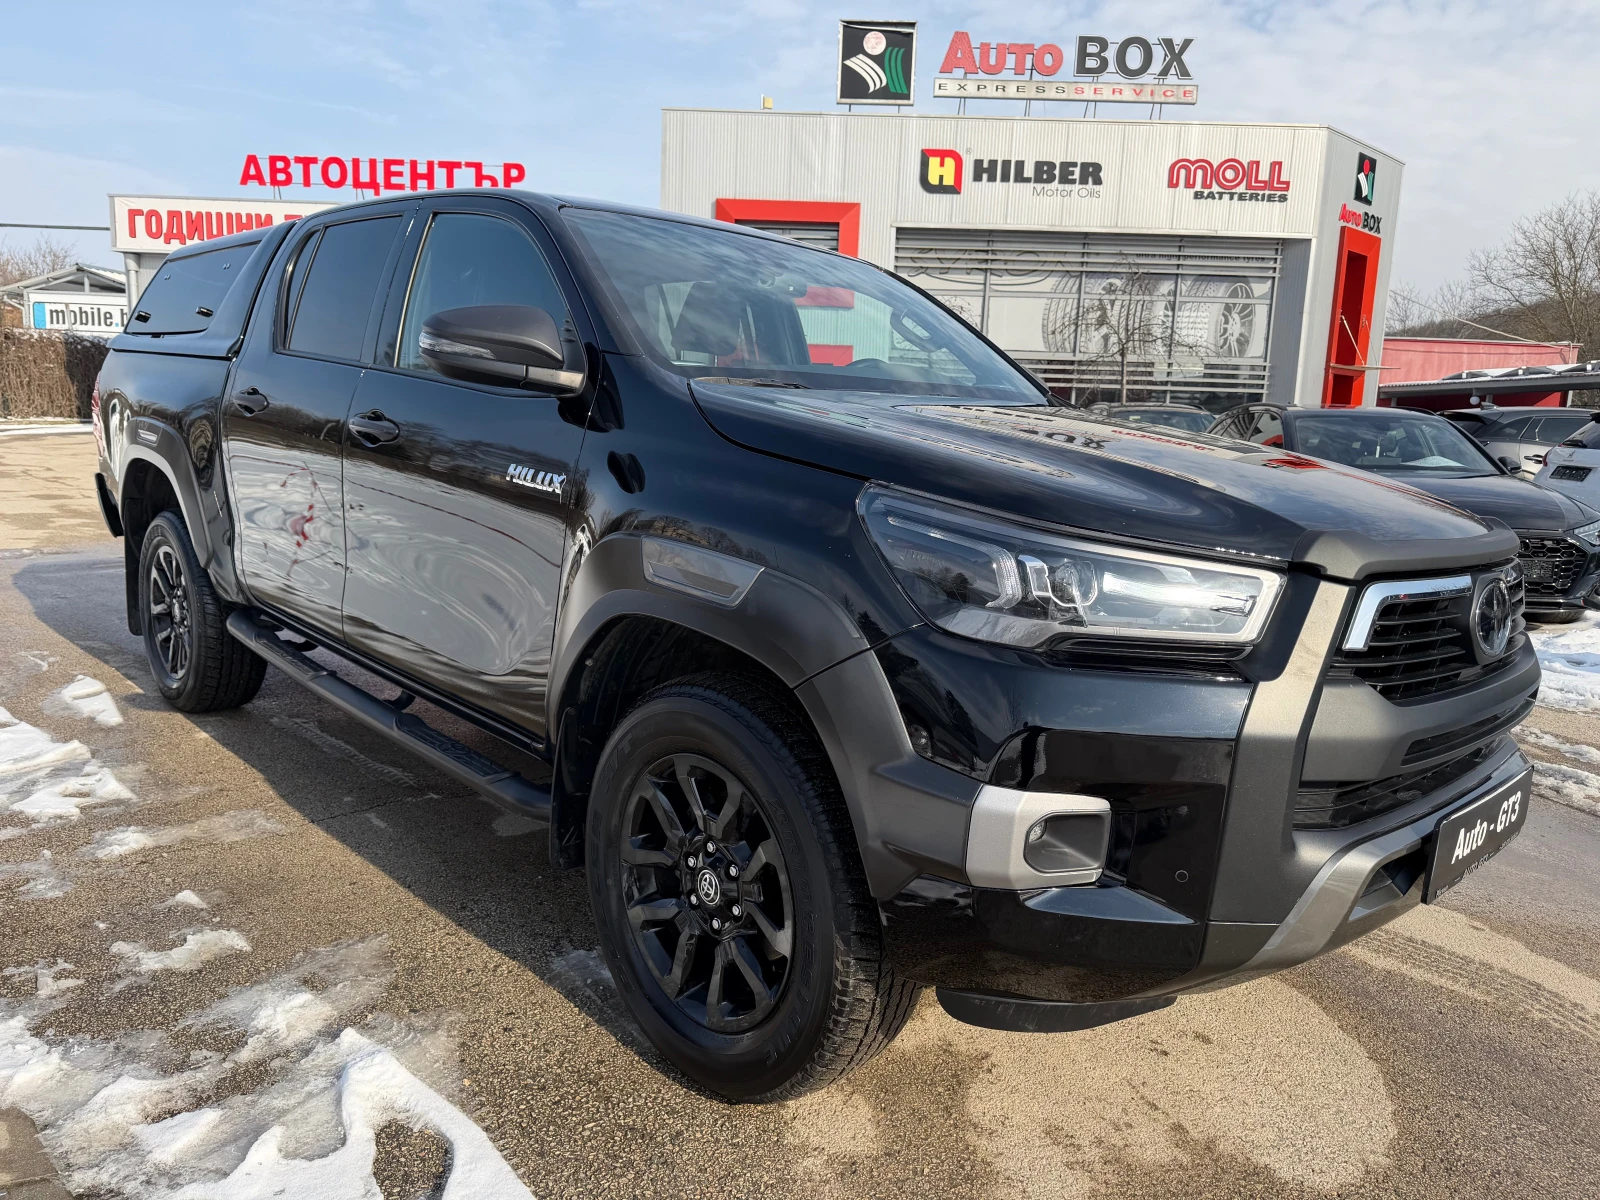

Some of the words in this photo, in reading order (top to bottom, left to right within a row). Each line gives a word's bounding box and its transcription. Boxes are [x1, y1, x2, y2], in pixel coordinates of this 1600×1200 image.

[1073, 34, 1198, 80] BOX
[239, 154, 526, 197] АВТОЦЕНТЪР
[972, 158, 1103, 186] HILBER
[1032, 186, 1074, 198] Motor
[1077, 186, 1101, 199] Oils
[1193, 190, 1289, 203] BATTERIES
[1362, 211, 1383, 234] BOX
[505, 463, 567, 495] HILUX
[1450, 818, 1488, 865] Auto
[1496, 790, 1522, 833] GT3
